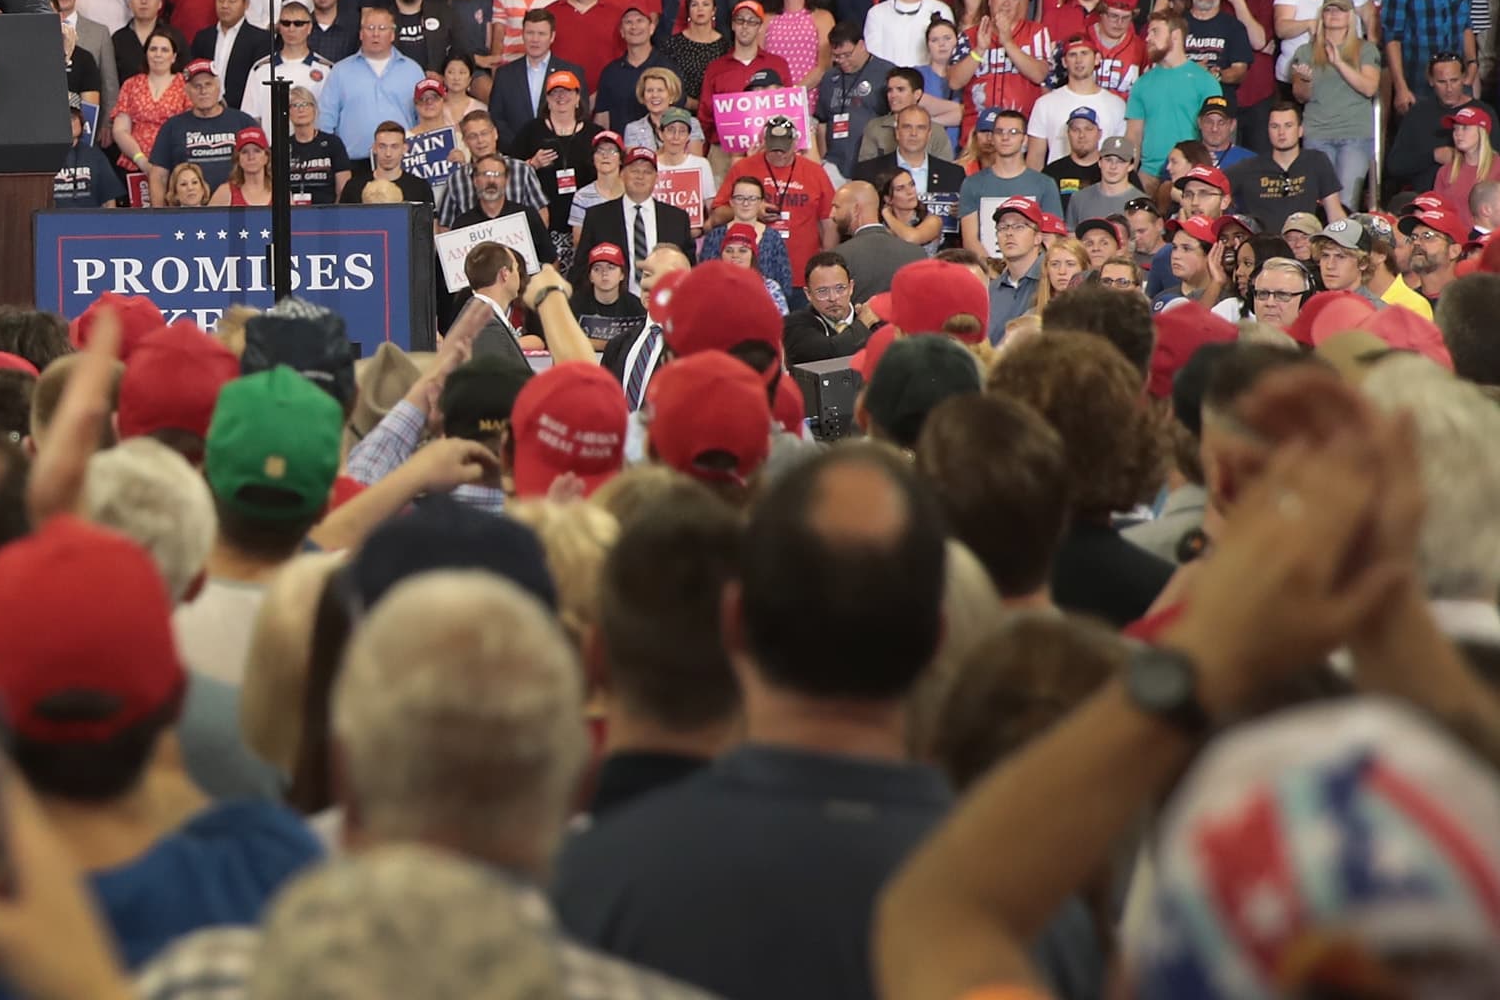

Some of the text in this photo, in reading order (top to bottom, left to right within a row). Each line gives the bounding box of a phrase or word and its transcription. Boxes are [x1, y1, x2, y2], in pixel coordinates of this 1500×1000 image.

[1185, 35, 1225, 48] AUBER
[715, 92, 804, 113] WOMEN
[744, 116, 769, 128] FO
[186, 133, 235, 146] STAUBER
[410, 133, 445, 156] AIN
[192, 146, 231, 156] CONGRESS
[403, 152, 426, 166] THE
[55, 167, 90, 179] AUER
[290, 172, 328, 180] COGRESS
[406, 159, 453, 180] AMP
[655, 180, 672, 189] KE
[140, 180, 150, 208] GREA
[653, 190, 699, 206] RICA
[765, 194, 808, 207] RUMP
[469, 227, 493, 242] BUY
[448, 231, 525, 262] AMAN
